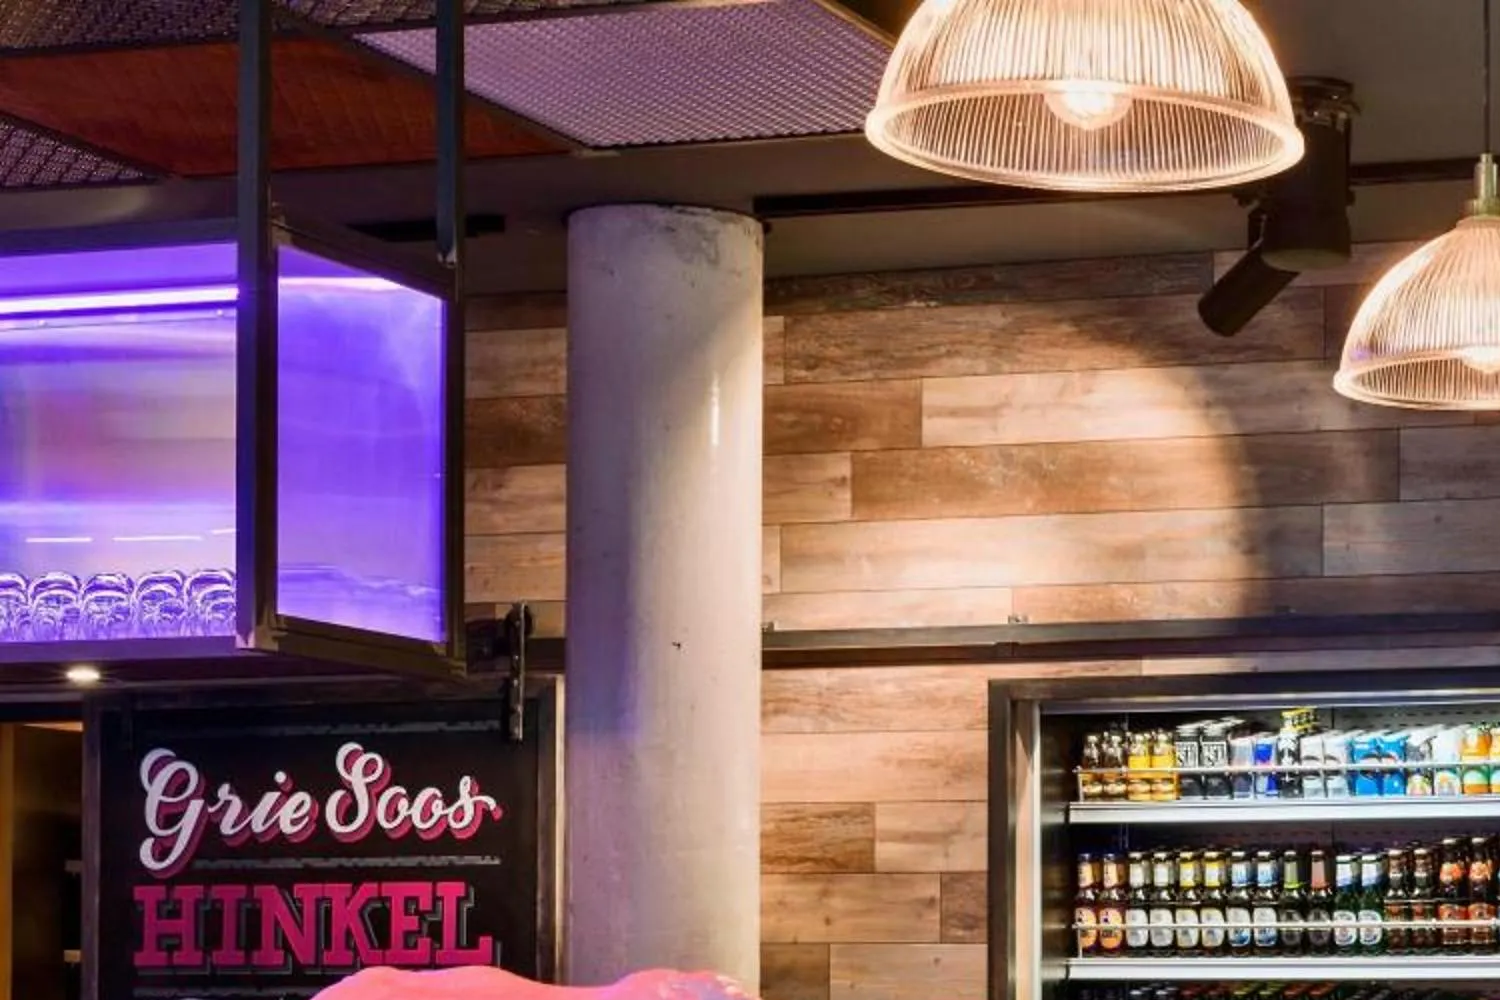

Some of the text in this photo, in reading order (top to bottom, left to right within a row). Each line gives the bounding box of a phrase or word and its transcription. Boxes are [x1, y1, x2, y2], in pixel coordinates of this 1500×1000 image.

[138, 741, 500, 873] Grie Soos
[132, 880, 496, 971] HINKEL
